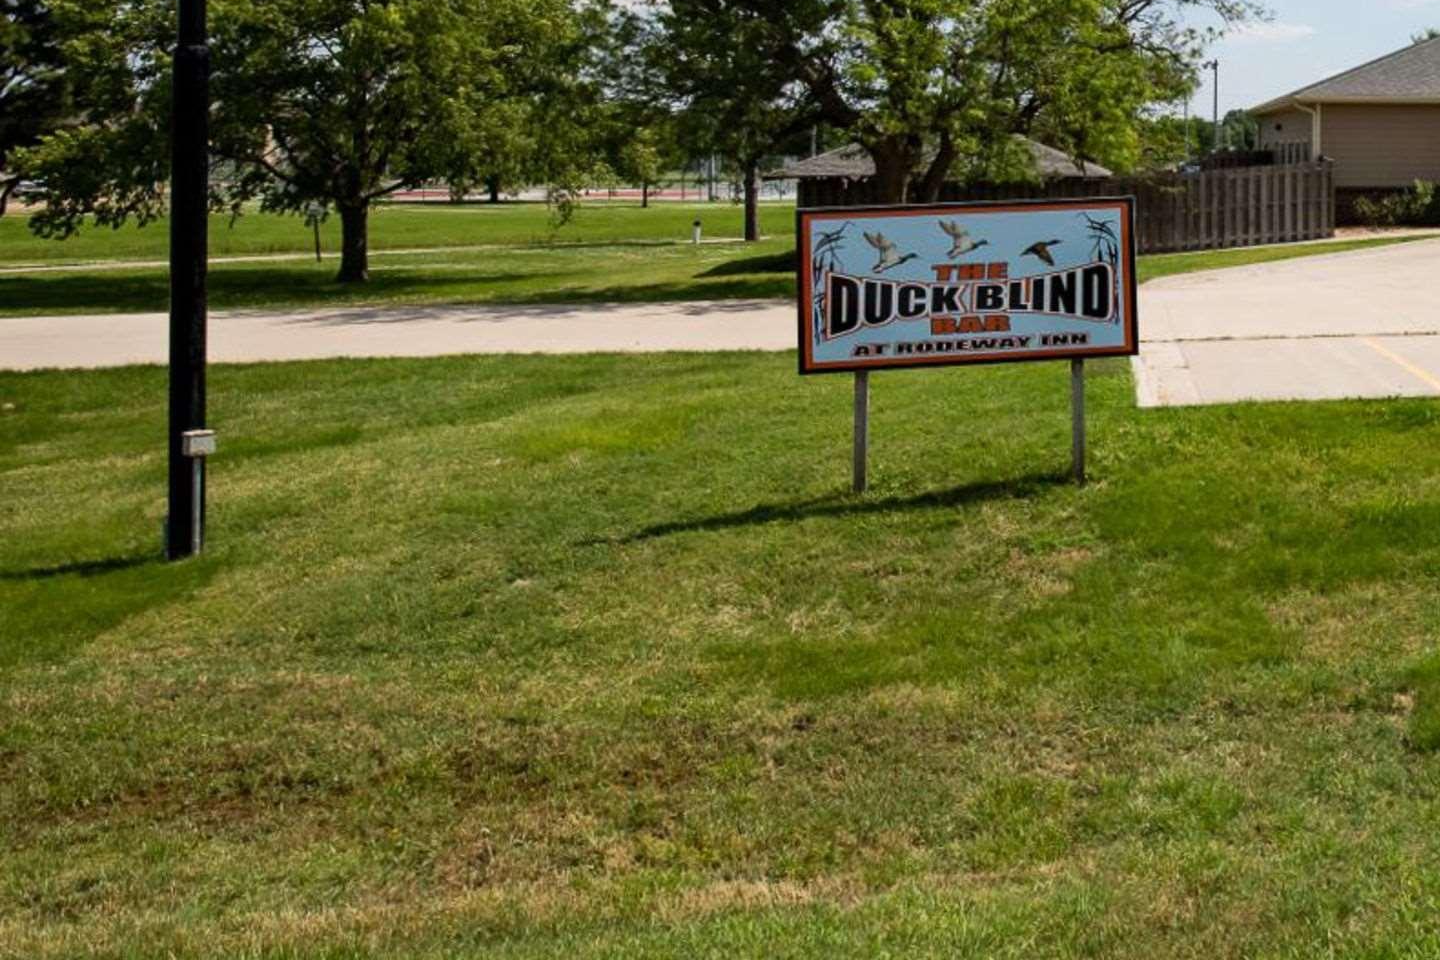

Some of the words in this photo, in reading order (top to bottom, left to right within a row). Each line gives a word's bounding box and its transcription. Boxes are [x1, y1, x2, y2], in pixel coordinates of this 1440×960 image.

[931, 262, 1009, 281] THE
[829, 273, 962, 337] DUCK
[975, 263, 1112, 319] BLIND
[930, 314, 1011, 336] BAR
[854, 342, 891, 357] AT
[897, 335, 1030, 355] RODEWAY
[1039, 333, 1088, 346] INN
